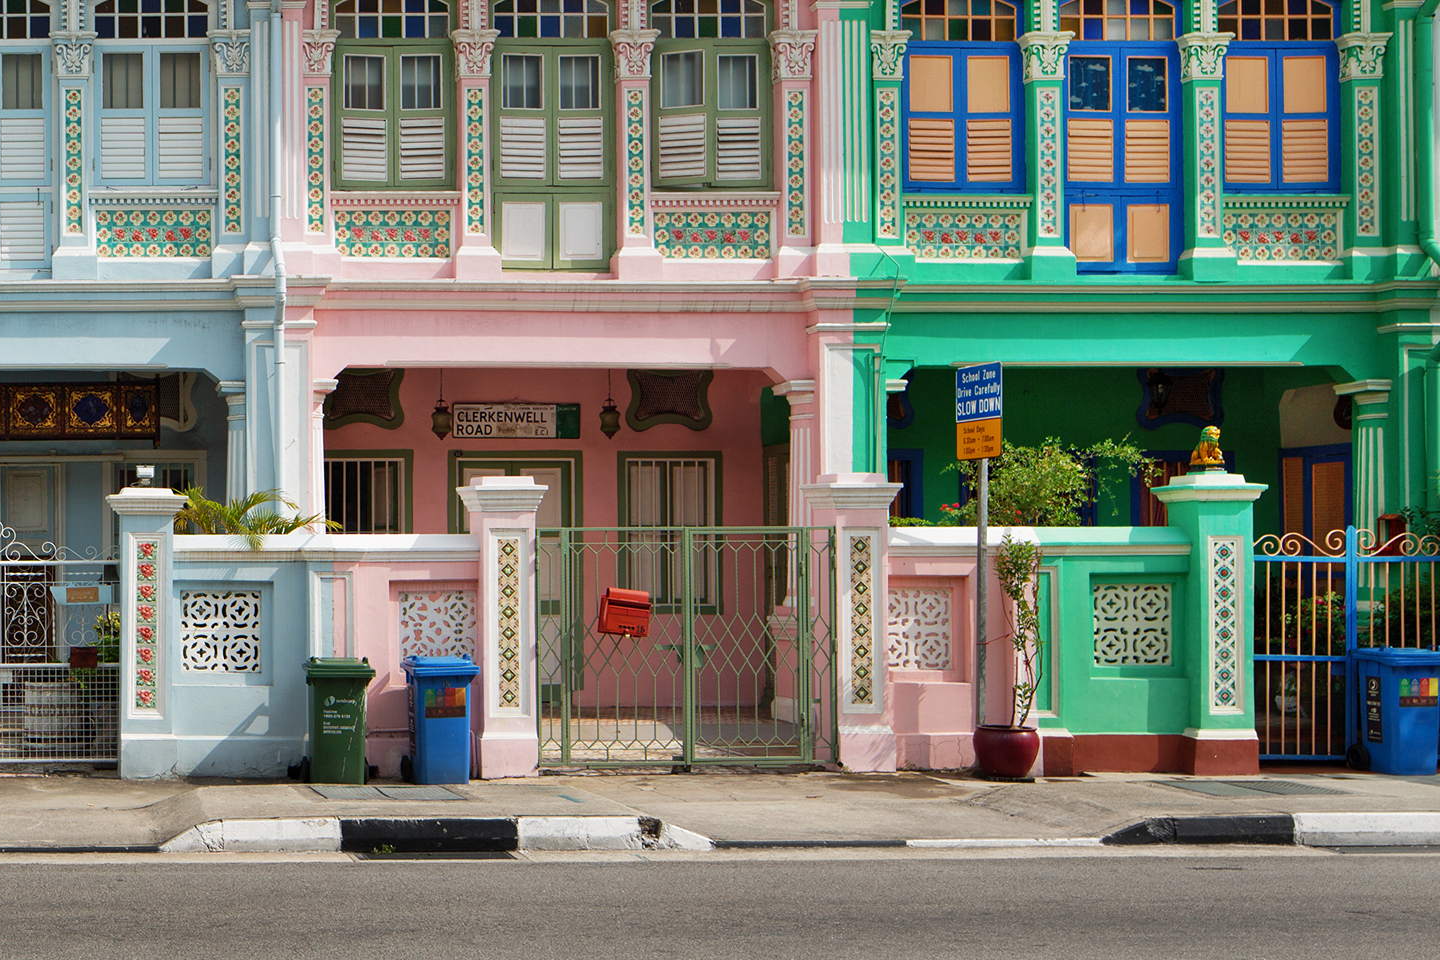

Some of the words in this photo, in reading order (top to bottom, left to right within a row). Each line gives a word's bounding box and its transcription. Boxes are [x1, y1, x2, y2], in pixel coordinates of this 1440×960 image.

[962, 370, 980, 384] School
[983, 369, 996, 381] Zone
[957, 387, 972, 398] Drive
[974, 382, 1000, 396] Carefully
[957, 400, 977, 416] SLOW
[979, 397, 1001, 414] DOWN
[457, 411, 548, 423] CLERKENWELL
[456, 424, 493, 436] ROAD
[963, 426, 975, 434] School
[976, 425, 985, 434] Days
[637, 625, 646, 633] 15
